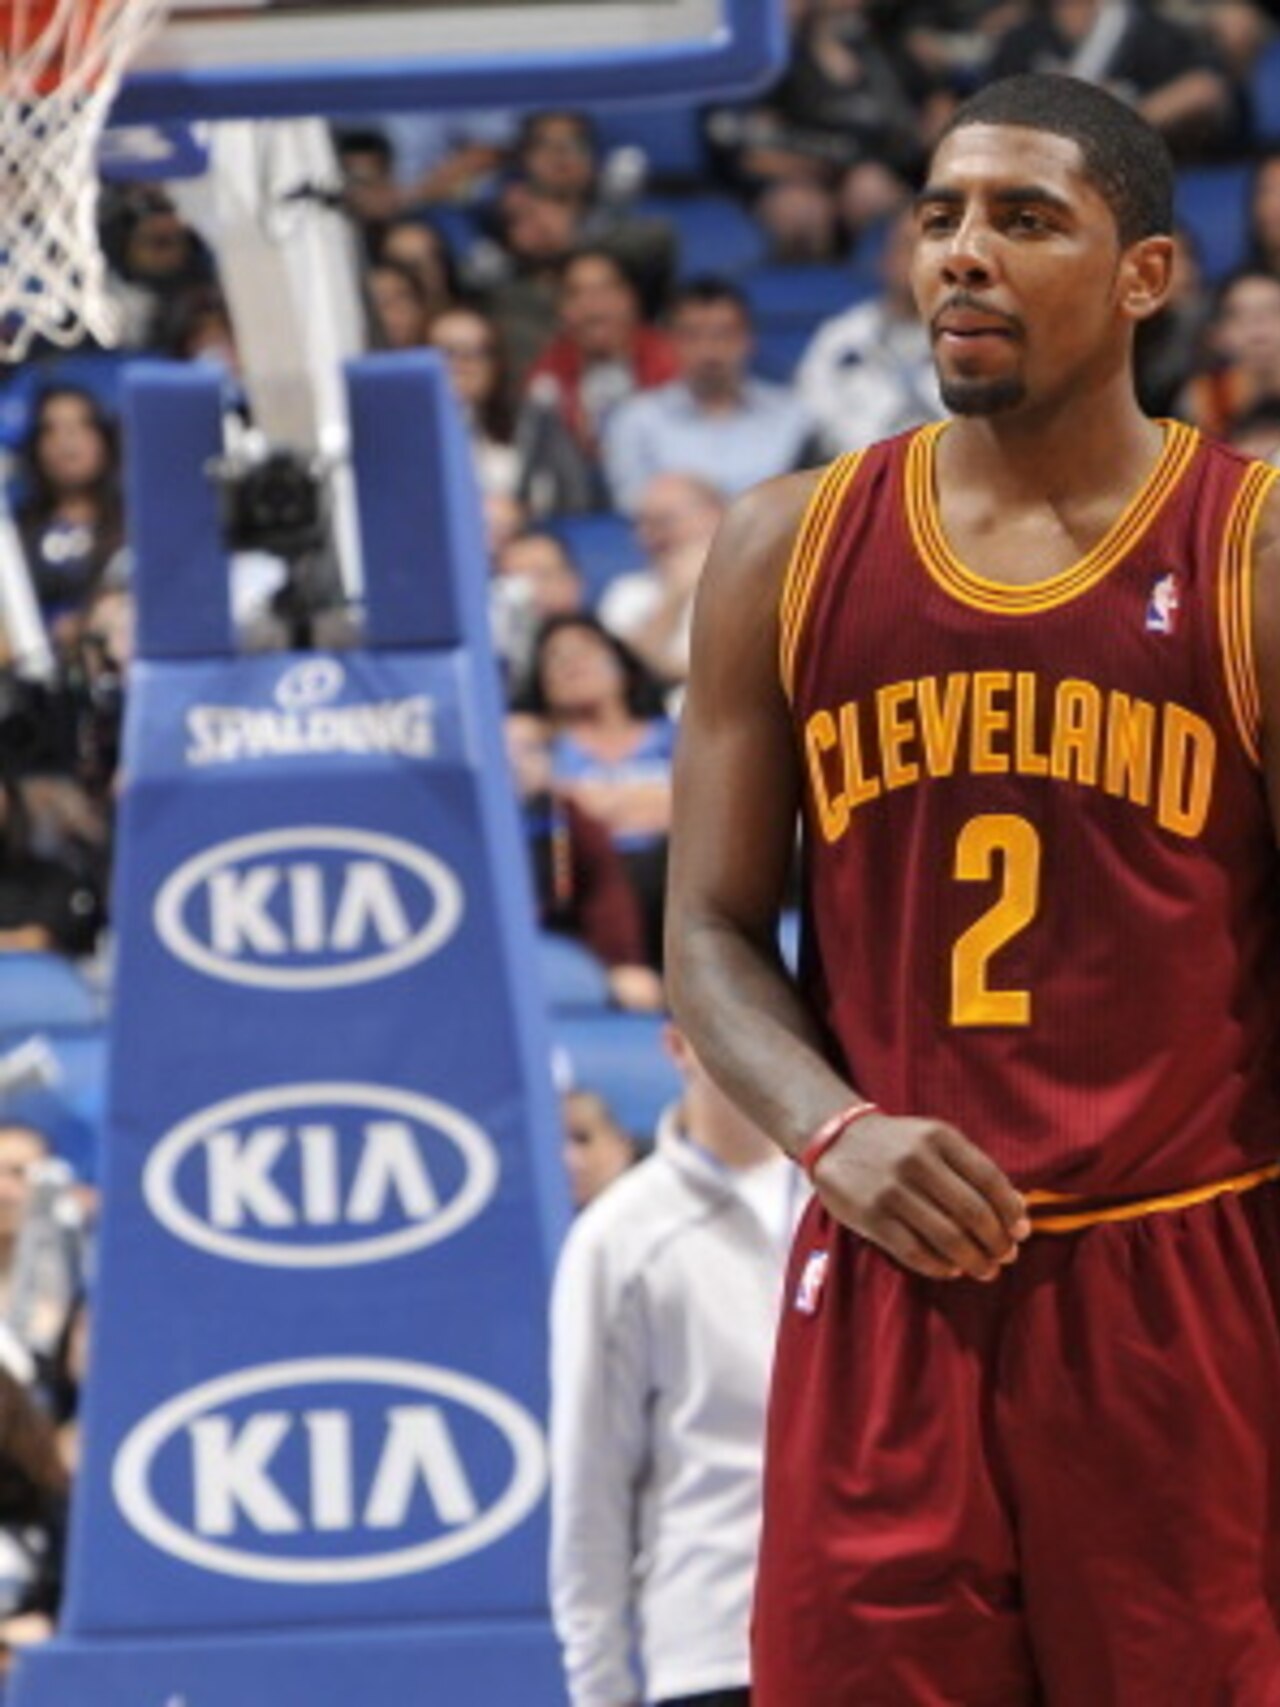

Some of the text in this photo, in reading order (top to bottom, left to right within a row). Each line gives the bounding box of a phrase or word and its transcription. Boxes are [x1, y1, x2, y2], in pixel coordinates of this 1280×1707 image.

[185, 696, 433, 765] SPALDING
[804, 671, 1217, 844] CLEVELAND
[208, 860, 408, 955] KIA
[950, 812, 1042, 1027] 2
[206, 1120, 440, 1230] KIA
[190, 1403, 478, 1536] KIA
